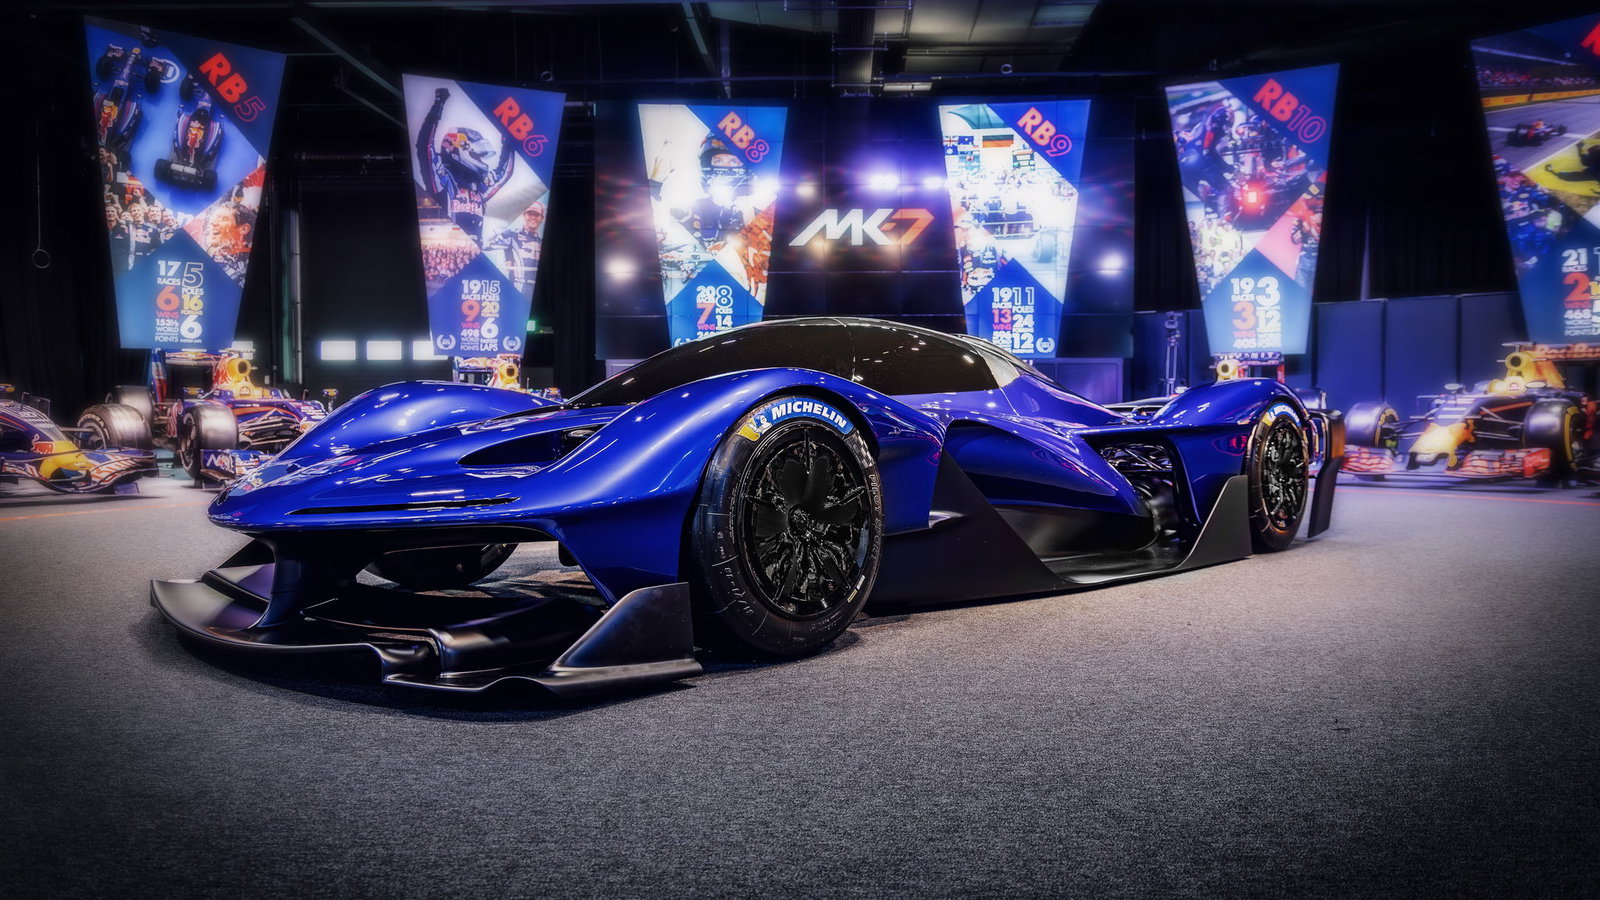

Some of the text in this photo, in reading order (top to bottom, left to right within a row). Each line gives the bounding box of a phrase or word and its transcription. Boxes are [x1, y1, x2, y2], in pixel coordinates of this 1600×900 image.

[199, 52, 267, 123] RB5
[1252, 78, 1327, 144] RB10
[493, 96, 549, 157] RB6
[1016, 107, 1073, 157] RB9
[717, 111, 770, 163] RB8
[1561, 248, 1588, 266] 21
[157, 260, 181, 277] 17
[182, 261, 204, 289] 5
[157, 277, 181, 286] RACES
[181, 287, 204, 296] POLES
[462, 279, 481, 294] 19
[481, 280, 500, 295] 15
[1231, 277, 1255, 294] 19
[1256, 276, 1281, 307] 3
[1564, 272, 1591, 301] 2
[156, 285, 180, 311] 6
[182, 294, 203, 311] 16
[716, 285, 733, 308] 8
[992, 287, 1012, 303] 19
[1012, 287, 1035, 306] 11
[461, 300, 480, 322] 9
[481, 301, 500, 313] 20
[696, 302, 716, 324] 7
[992, 308, 1012, 324] 13
[1232, 301, 1256, 330] 3
[180, 314, 203, 339] 6
[481, 317, 499, 339] 6
[715, 315, 733, 328] 14
[1013, 314, 1035, 328] 24
[1257, 310, 1281, 331] 12
[461, 329, 480, 338] 498
[1013, 332, 1035, 349] 12
[481, 343, 499, 352] LAPS
[771, 400, 848, 429] MICHELIN
